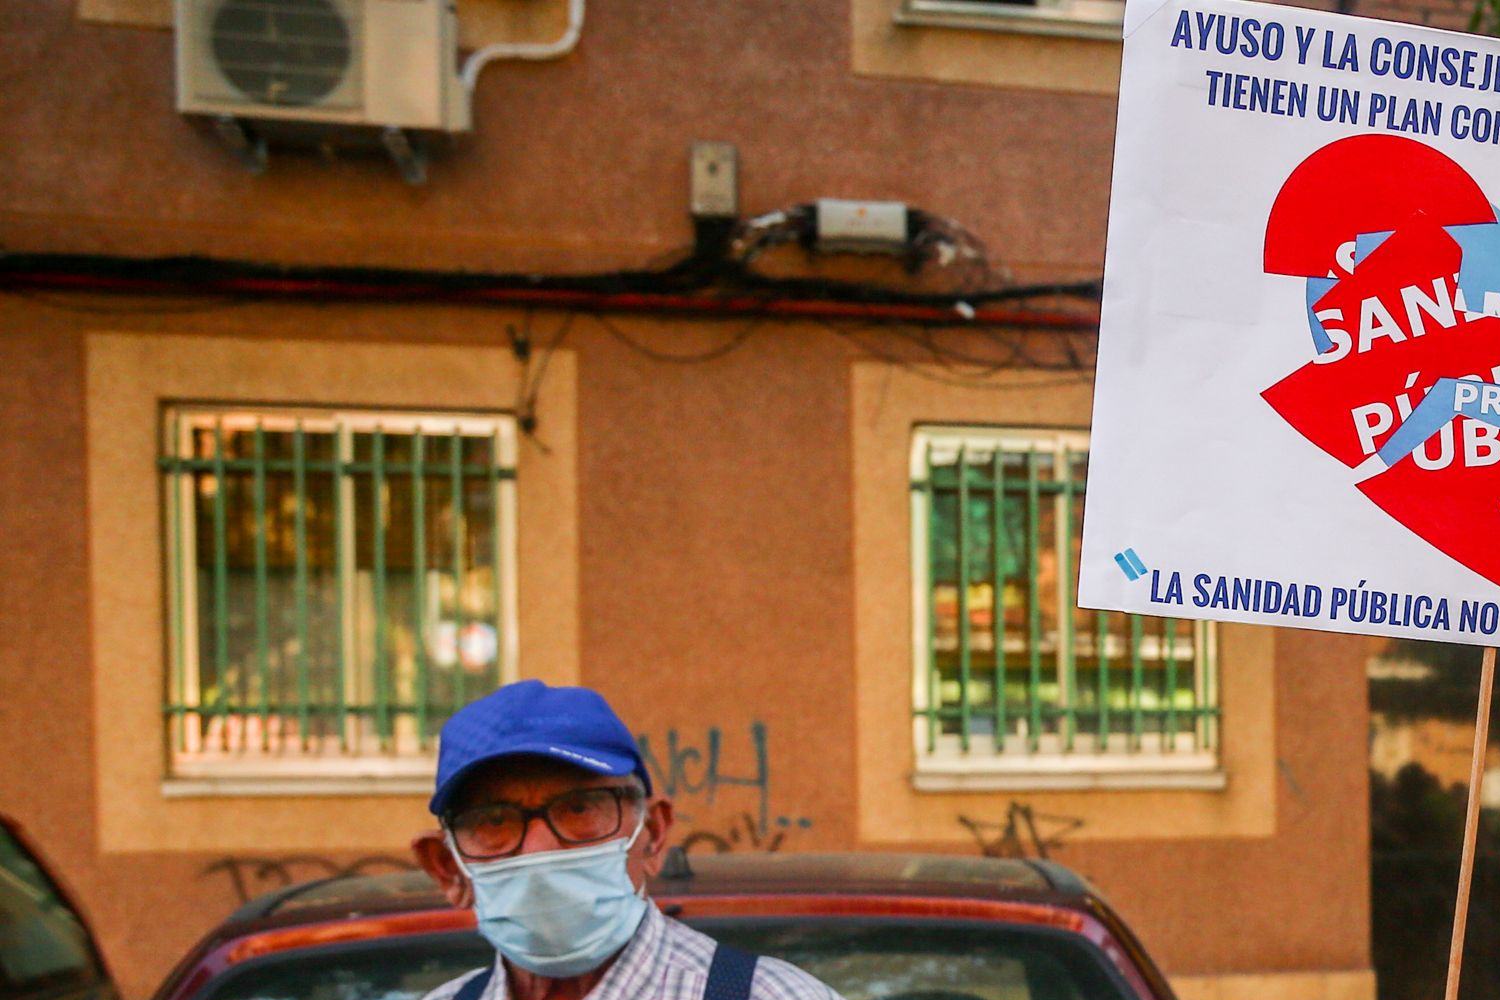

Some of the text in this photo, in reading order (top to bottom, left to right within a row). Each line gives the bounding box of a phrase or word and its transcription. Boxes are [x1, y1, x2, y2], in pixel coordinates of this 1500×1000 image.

[1171, 10, 1285, 61] AYUSO
[1295, 26, 1316, 65] Y
[1322, 30, 1360, 72] LA
[1206, 70, 1308, 118] TIENEN
[1316, 86, 1361, 125] UN
[1367, 93, 1444, 137] PLAN
[1150, 569, 1184, 606] LA
[1192, 573, 1322, 618] SANIDAD
[1330, 579, 1451, 631] PÚBLICA
[1458, 601, 1499, 635] NO
